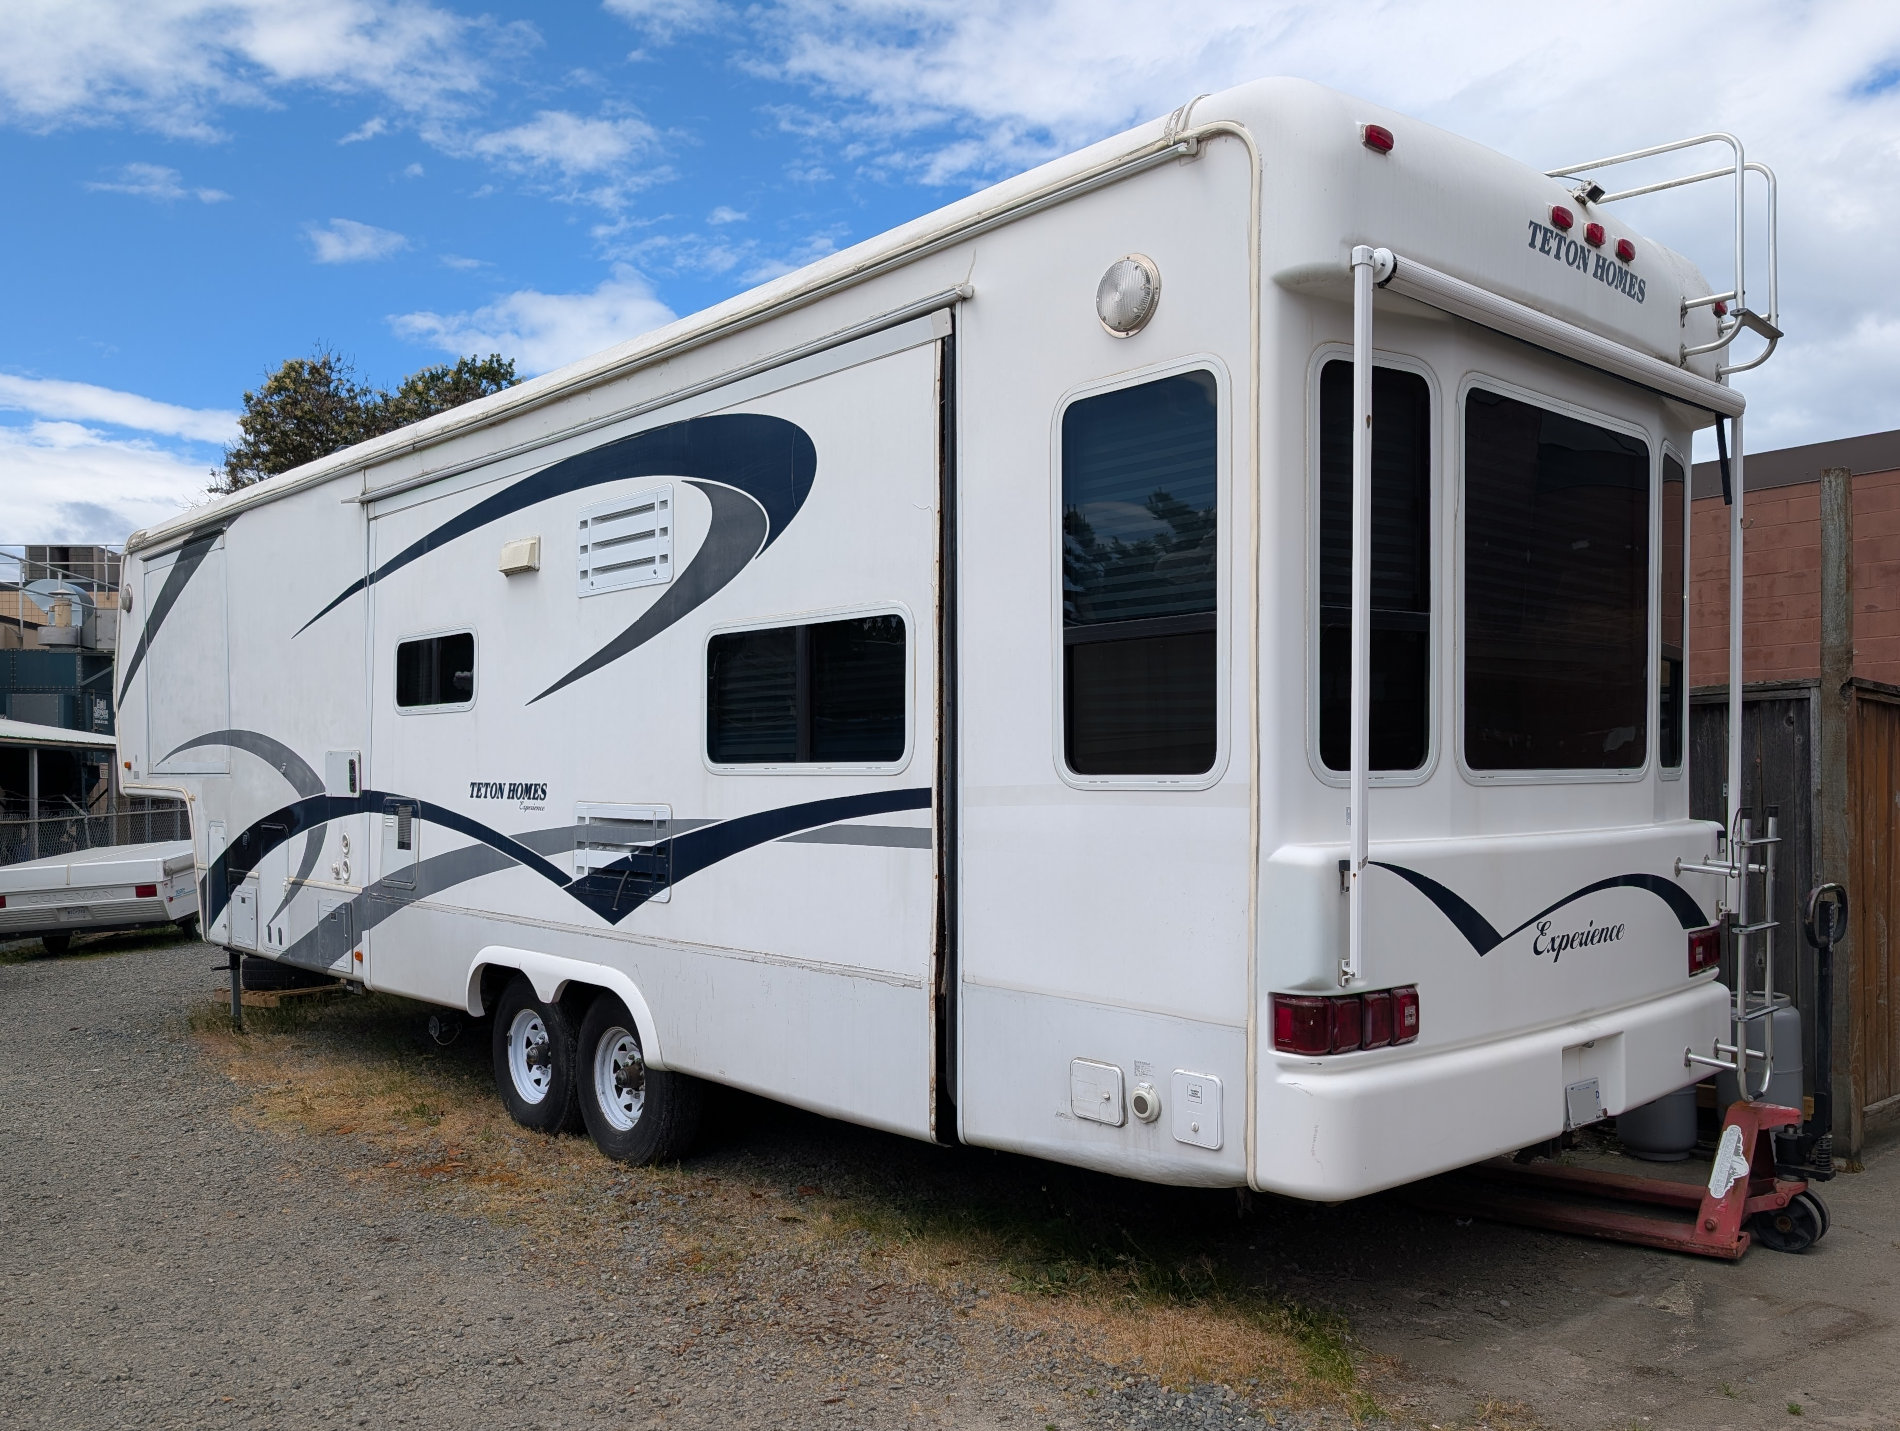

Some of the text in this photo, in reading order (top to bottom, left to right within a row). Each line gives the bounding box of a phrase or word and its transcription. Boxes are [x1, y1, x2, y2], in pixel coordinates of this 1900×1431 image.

[1528, 220, 1646, 304] TETON HOMES
[469, 782, 547, 801] TETON HOMES
[519, 801, 545, 813] Experience
[28, 889, 115, 904] COLEMAN
[1533, 920, 1625, 963] Experience
